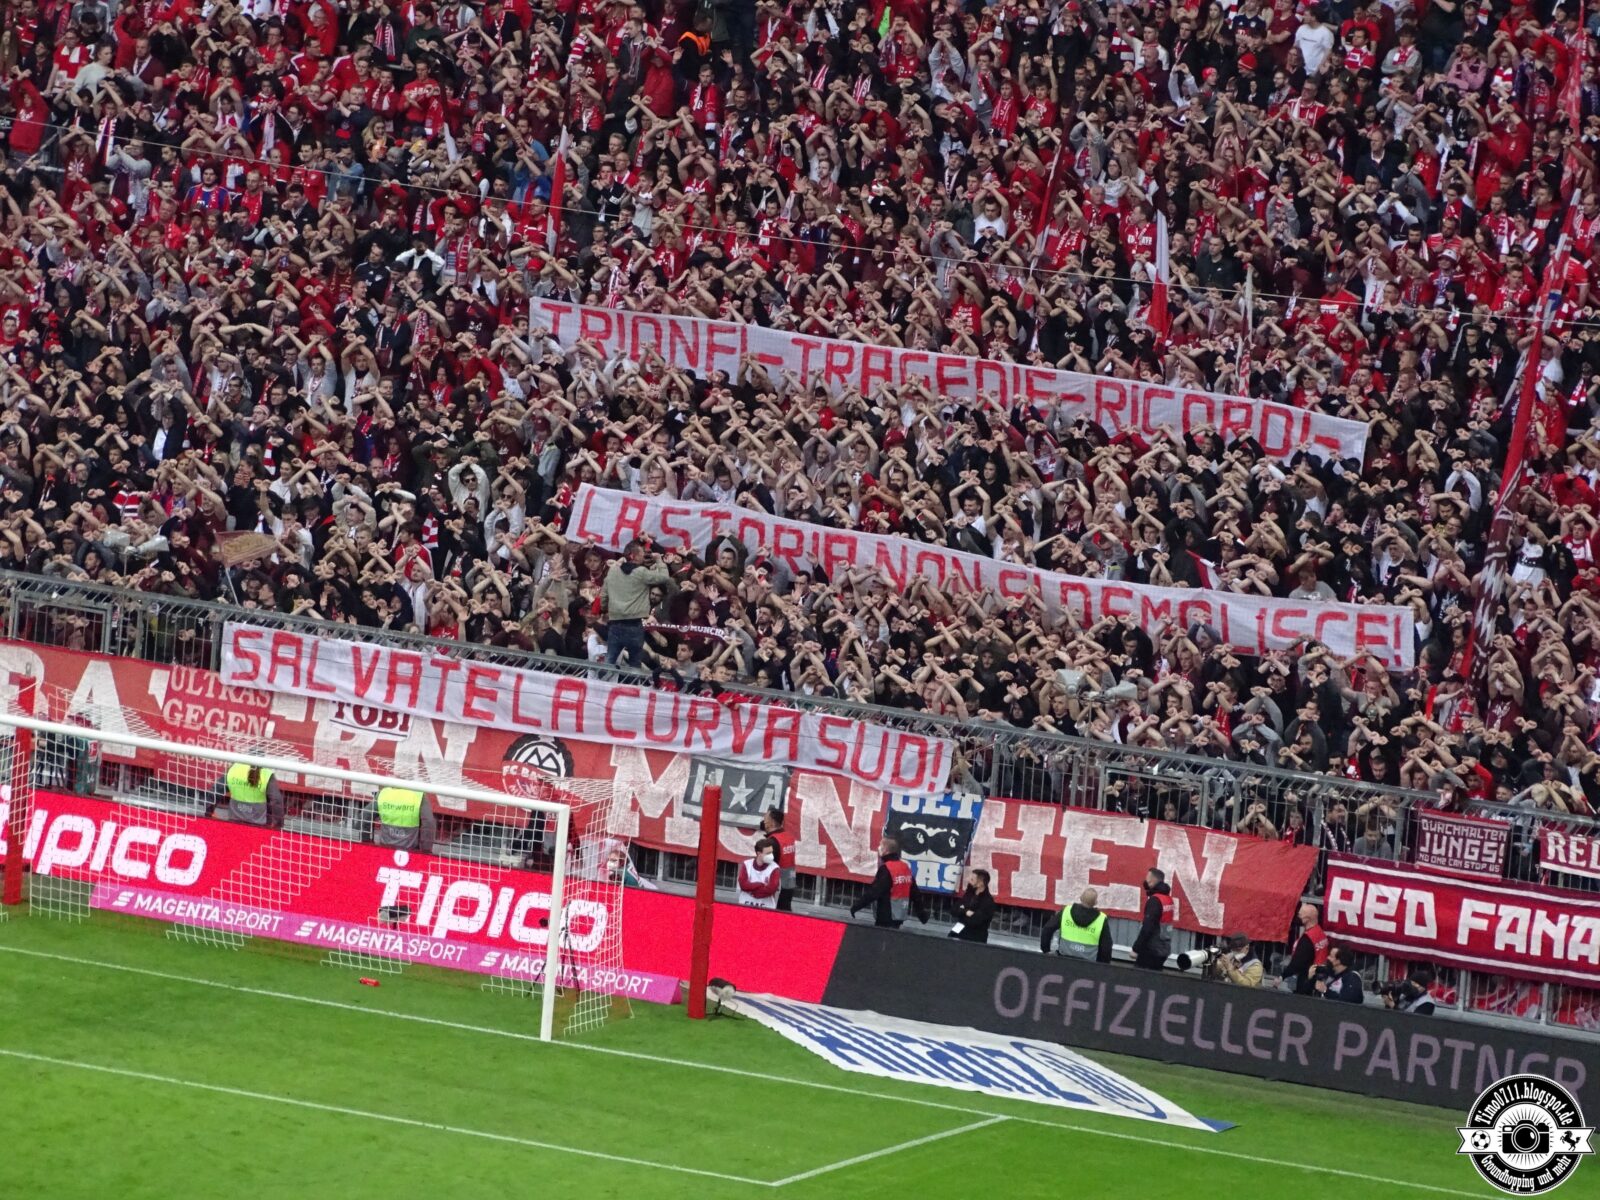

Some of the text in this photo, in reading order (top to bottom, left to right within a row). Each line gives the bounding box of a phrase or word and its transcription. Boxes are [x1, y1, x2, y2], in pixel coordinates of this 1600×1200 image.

[814, 716, 943, 792] SUD!
[1419, 832, 1505, 864] JUNGS!
[134, 896, 283, 932] MAGENTA SPORT
[317, 923, 467, 962] MAGENTA SPORT
[592, 969, 654, 995] SPORT
[994, 966, 1313, 1066] OFFIZIELLER
